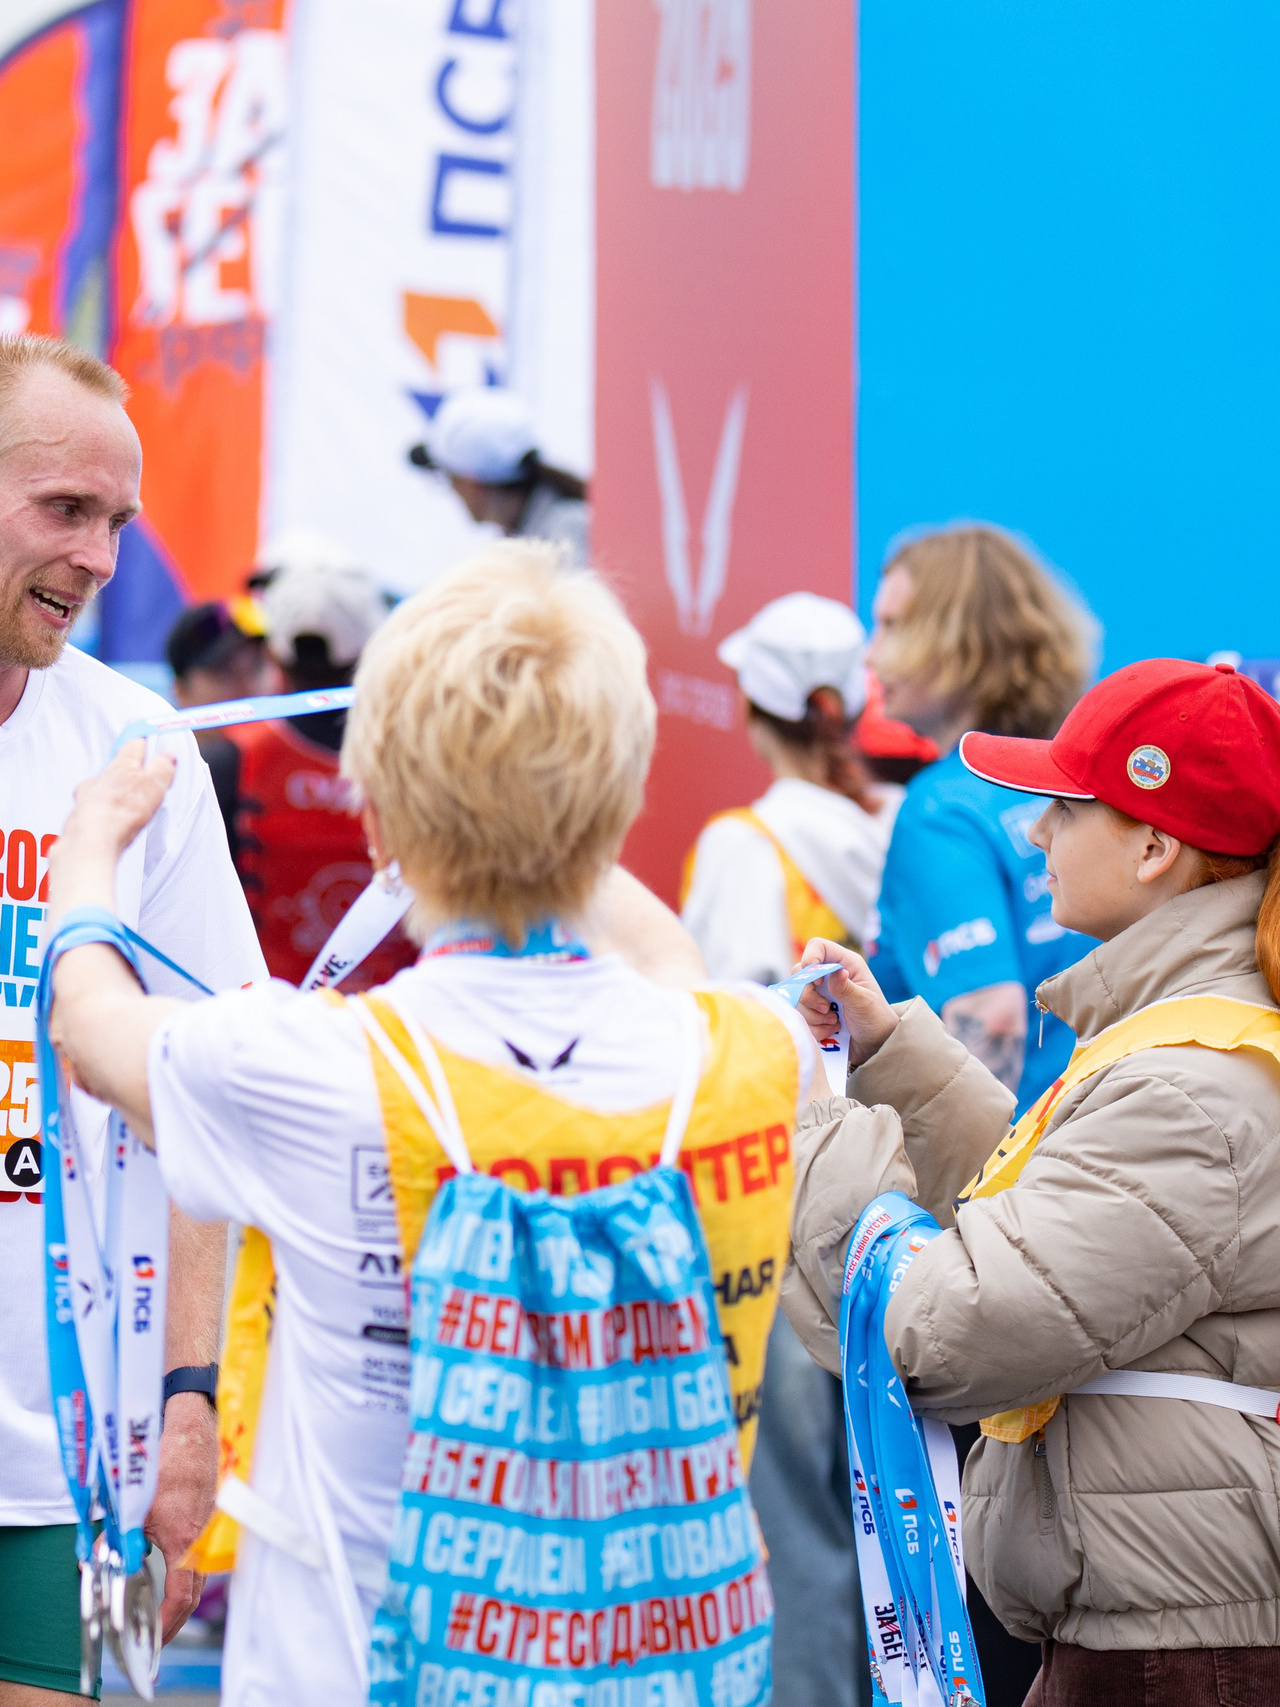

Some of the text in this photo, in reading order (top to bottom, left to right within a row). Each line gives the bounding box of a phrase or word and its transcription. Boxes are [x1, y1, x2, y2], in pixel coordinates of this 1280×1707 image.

[434, 1122, 789, 1207] ОЛОТЕР
[867, 1213, 892, 1238] ОТСТАЛ
[133, 1286, 152, 1333] ПСБ
[858, 1495, 876, 1536] ПСБ
[902, 1514, 920, 1555] ПСБ
[948, 1630, 965, 1672] ПСБ
